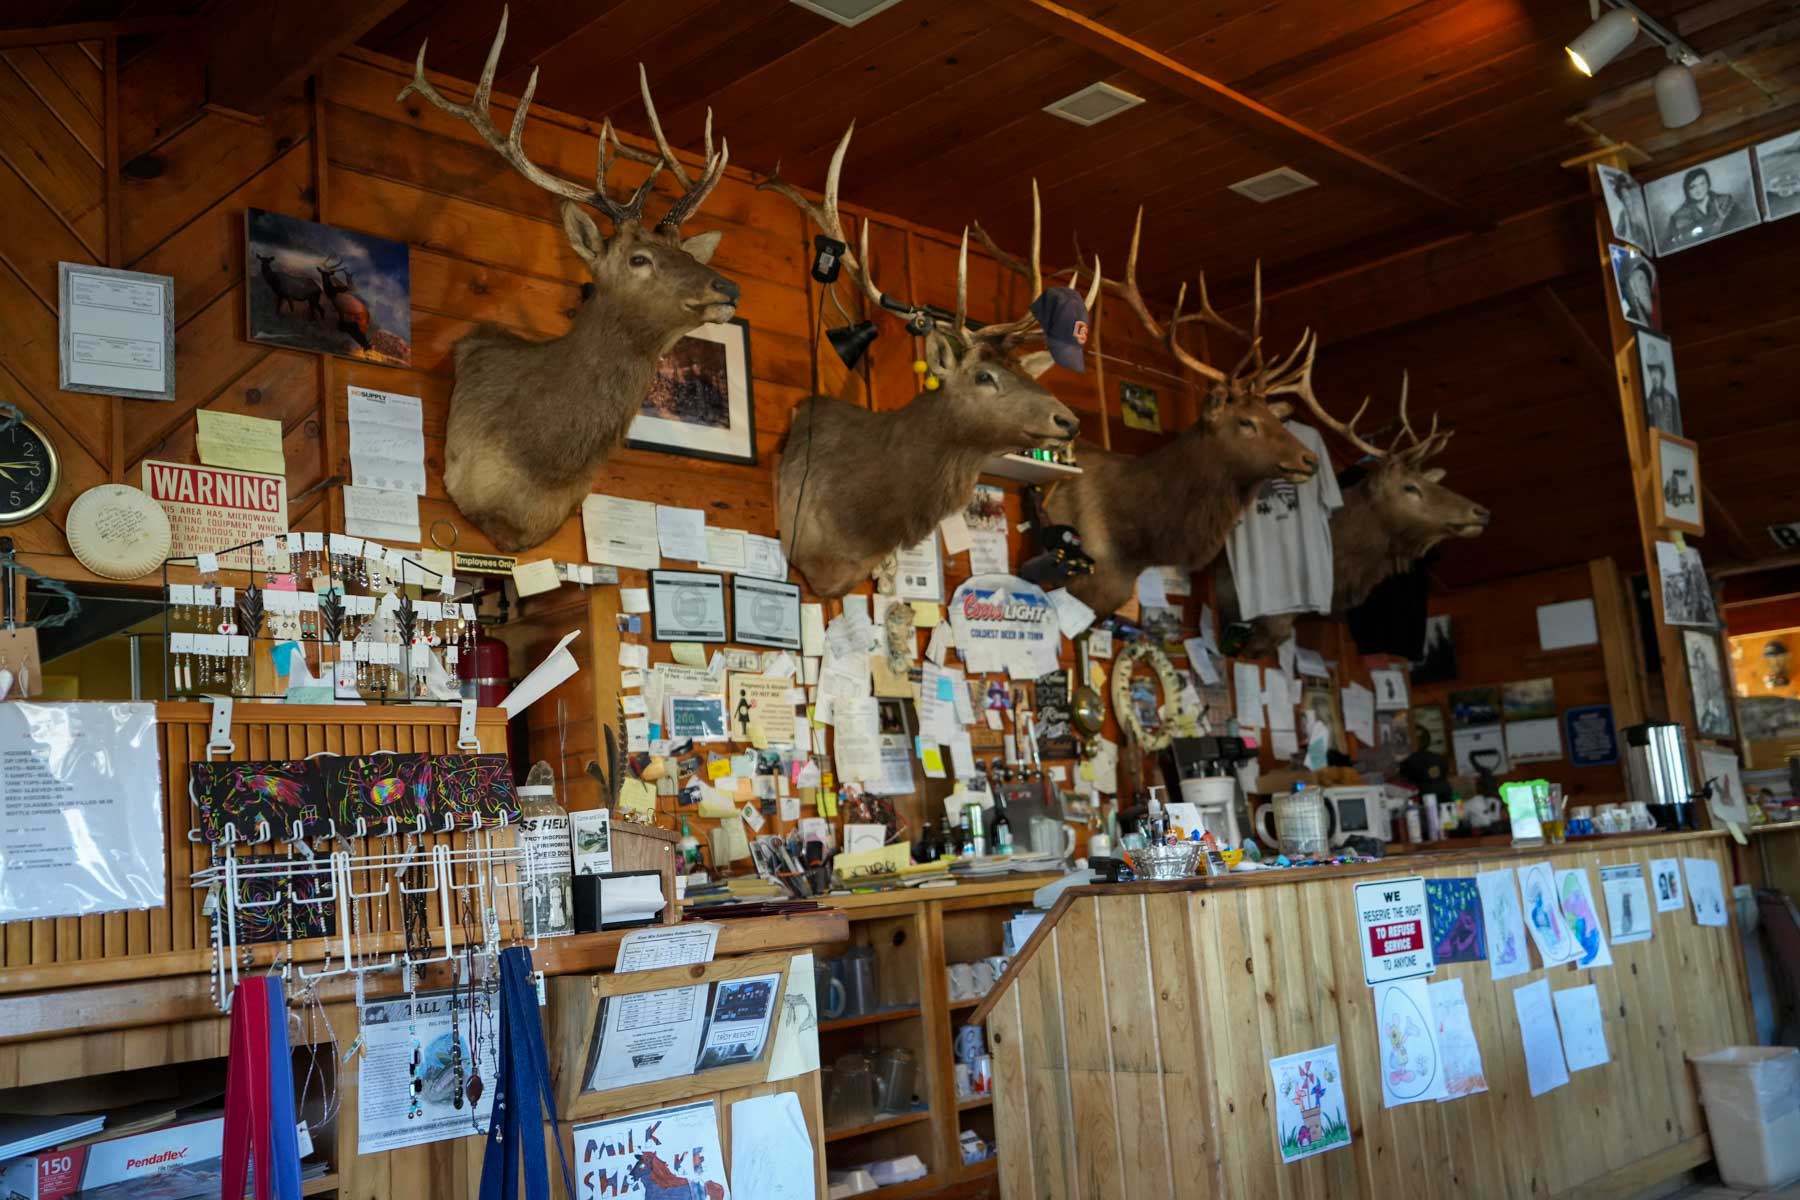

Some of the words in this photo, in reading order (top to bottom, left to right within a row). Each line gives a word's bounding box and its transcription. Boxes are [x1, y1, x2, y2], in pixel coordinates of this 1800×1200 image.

[22, 442, 34, 457] 2
[24, 480, 34, 493] 4
[153, 466, 278, 512] WARNING
[9, 491, 21, 506] 5
[162, 505, 174, 513] HIS
[180, 506, 202, 515] AREA
[207, 509, 223, 518] HAS
[228, 512, 276, 523] MICROWAVE
[168, 516, 202, 525] ERATING
[208, 519, 252, 531] EQUIPMENT
[258, 524, 282, 532] WHICH
[185, 526, 233, 537] HAZARDOUS
[237, 530, 246, 538] TO
[184, 535, 230, 546] IMPLANTED
[188, 544, 213, 553] OTHER
[456, 556, 497, 568] Employees
[963, 592, 1004, 621] Coors
[1004, 605, 1046, 623] LIGHT
[970, 629, 999, 639] COLDEST
[1001, 630, 1016, 639] BEER
[1018, 631, 1025, 640] IN
[1027, 632, 1044, 641] TOWN
[1383, 891, 1401, 902] WE
[1363, 908, 1391, 922] RESERVE
[1392, 906, 1404, 918] THE
[1405, 904, 1422, 917] RIGHT
[1376, 927, 1386, 939] TO
[1387, 923, 1416, 938] REFUSE
[1384, 937, 1411, 953] SERVICE
[1383, 959, 1391, 970] TO
[1393, 955, 1416, 968] ANYONE
[405, 1002, 441, 1016] TALL
[446, 997, 482, 1012] TALE
[584, 1121, 662, 1162] MILK
[41, 1156, 72, 1176] 150
[126, 1147, 189, 1170] Pendaflex
